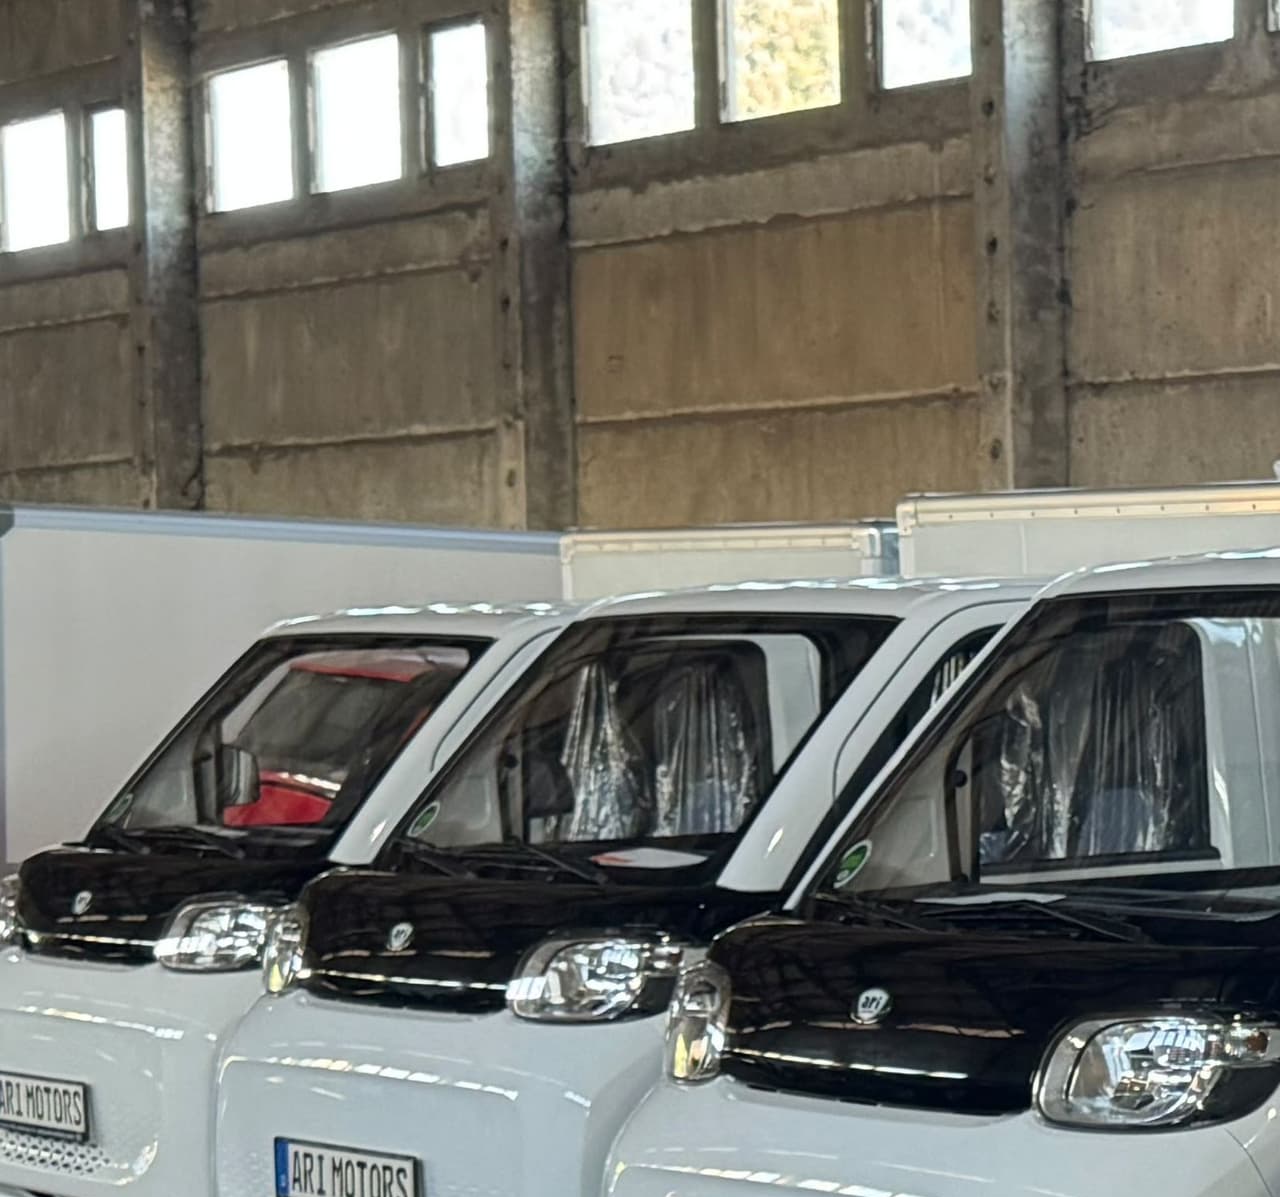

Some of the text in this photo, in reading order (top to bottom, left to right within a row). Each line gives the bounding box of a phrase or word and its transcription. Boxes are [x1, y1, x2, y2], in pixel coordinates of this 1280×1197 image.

[862, 996, 883, 1010] ari
[25, 1084, 82, 1126] MOTORS
[292, 1150, 326, 1196] ARI
